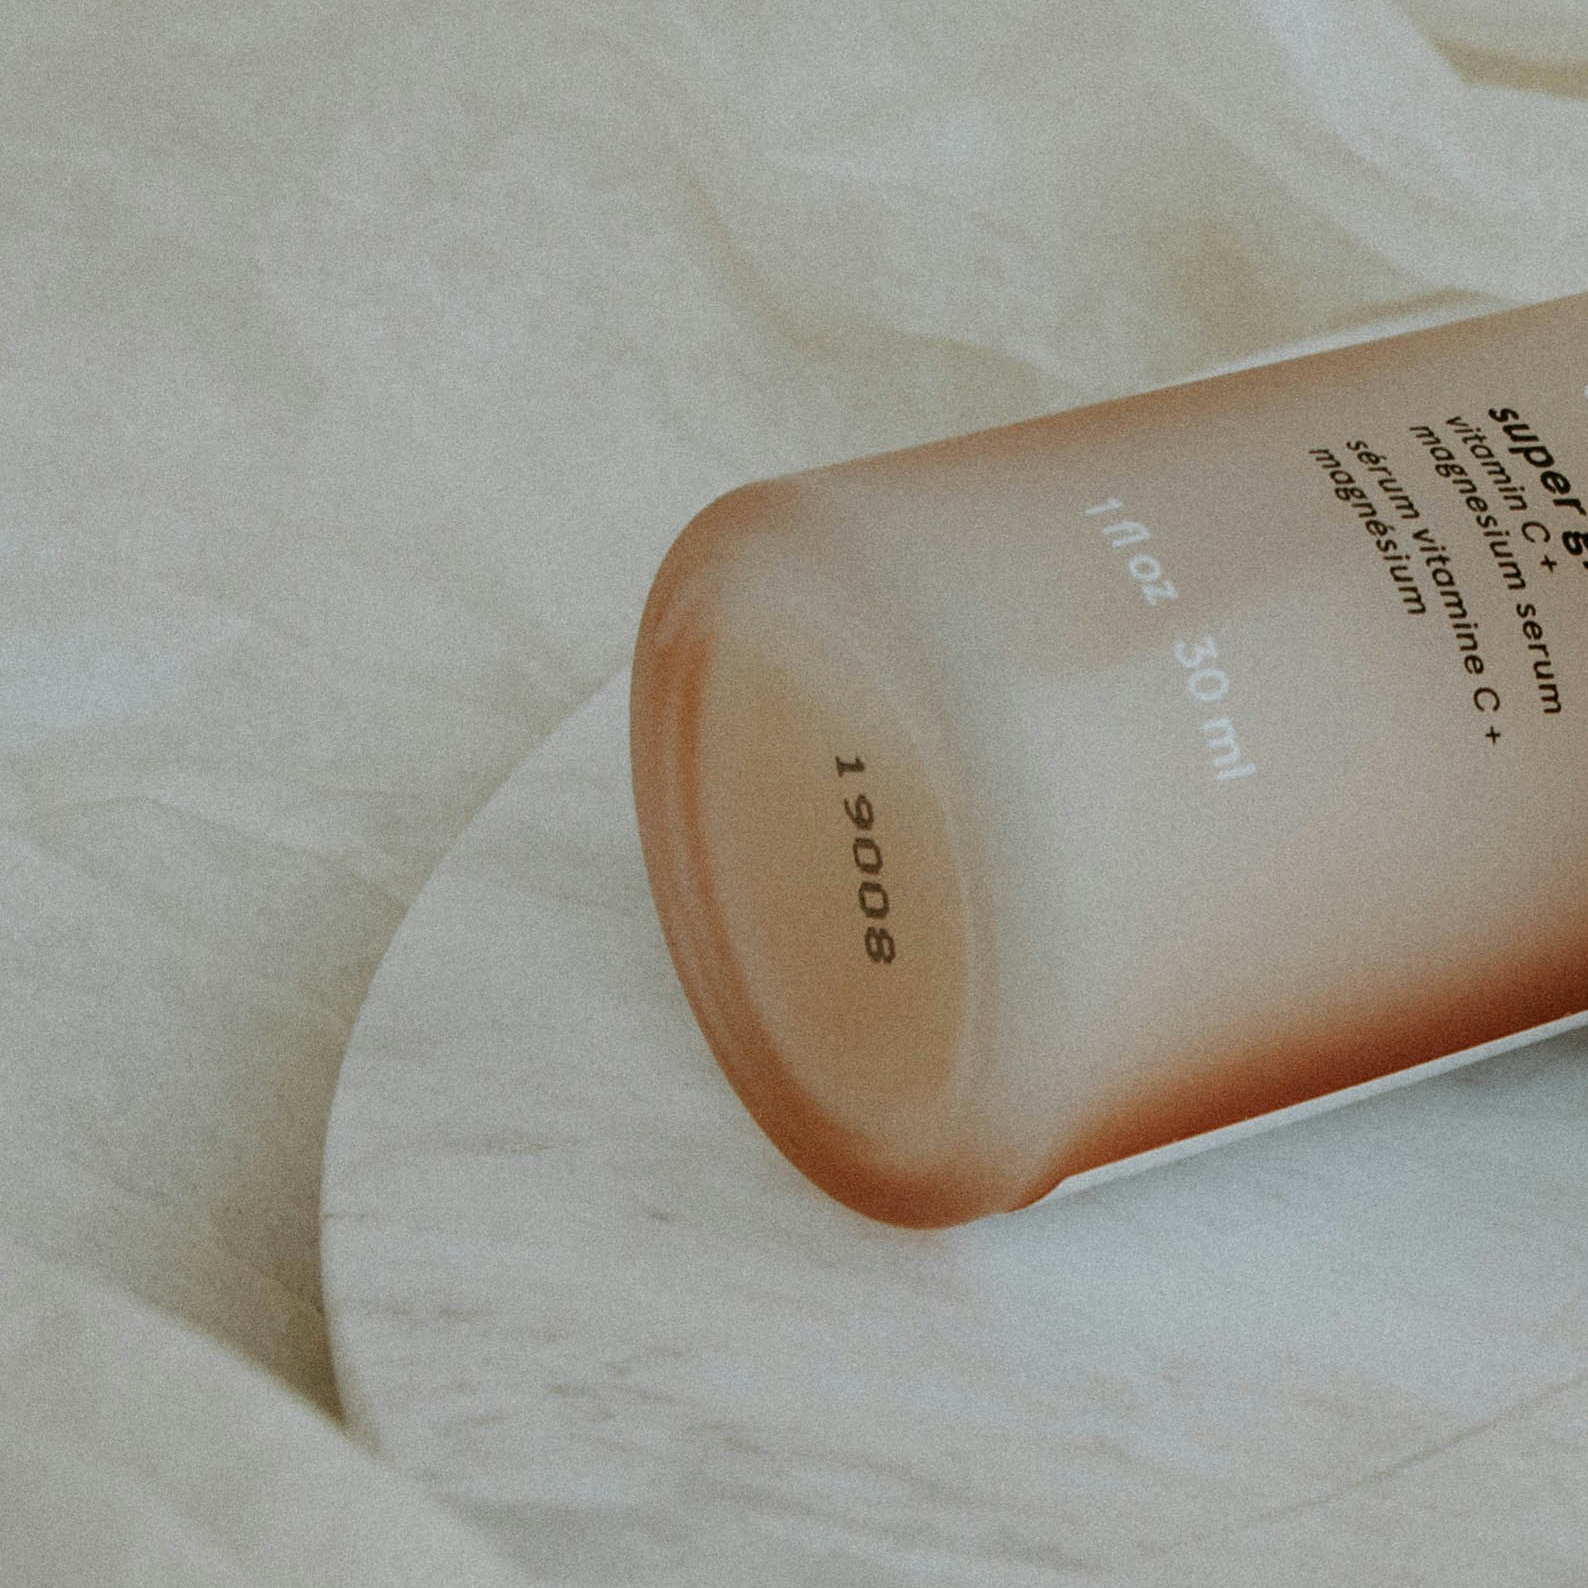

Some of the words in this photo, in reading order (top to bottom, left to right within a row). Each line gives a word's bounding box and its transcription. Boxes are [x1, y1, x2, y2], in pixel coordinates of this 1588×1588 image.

[1308, 447, 1427, 615] magnésium
[1446, 415, 1528, 512] vitamin
[1521, 520, 1551, 543] C
[1488, 406, 1587, 518] super
[1129, 555, 1178, 605] oz
[1174, 636, 1230, 701] 30
[1203, 717, 1255, 781] ml
[1346, 439, 1420, 521] sérum
[1412, 528, 1485, 676] vitamine
[1473, 686, 1501, 712] C
[1410, 424, 1526, 591] magnesium
[1516, 603, 1562, 715] serum
[835, 756, 896, 964] 19008
